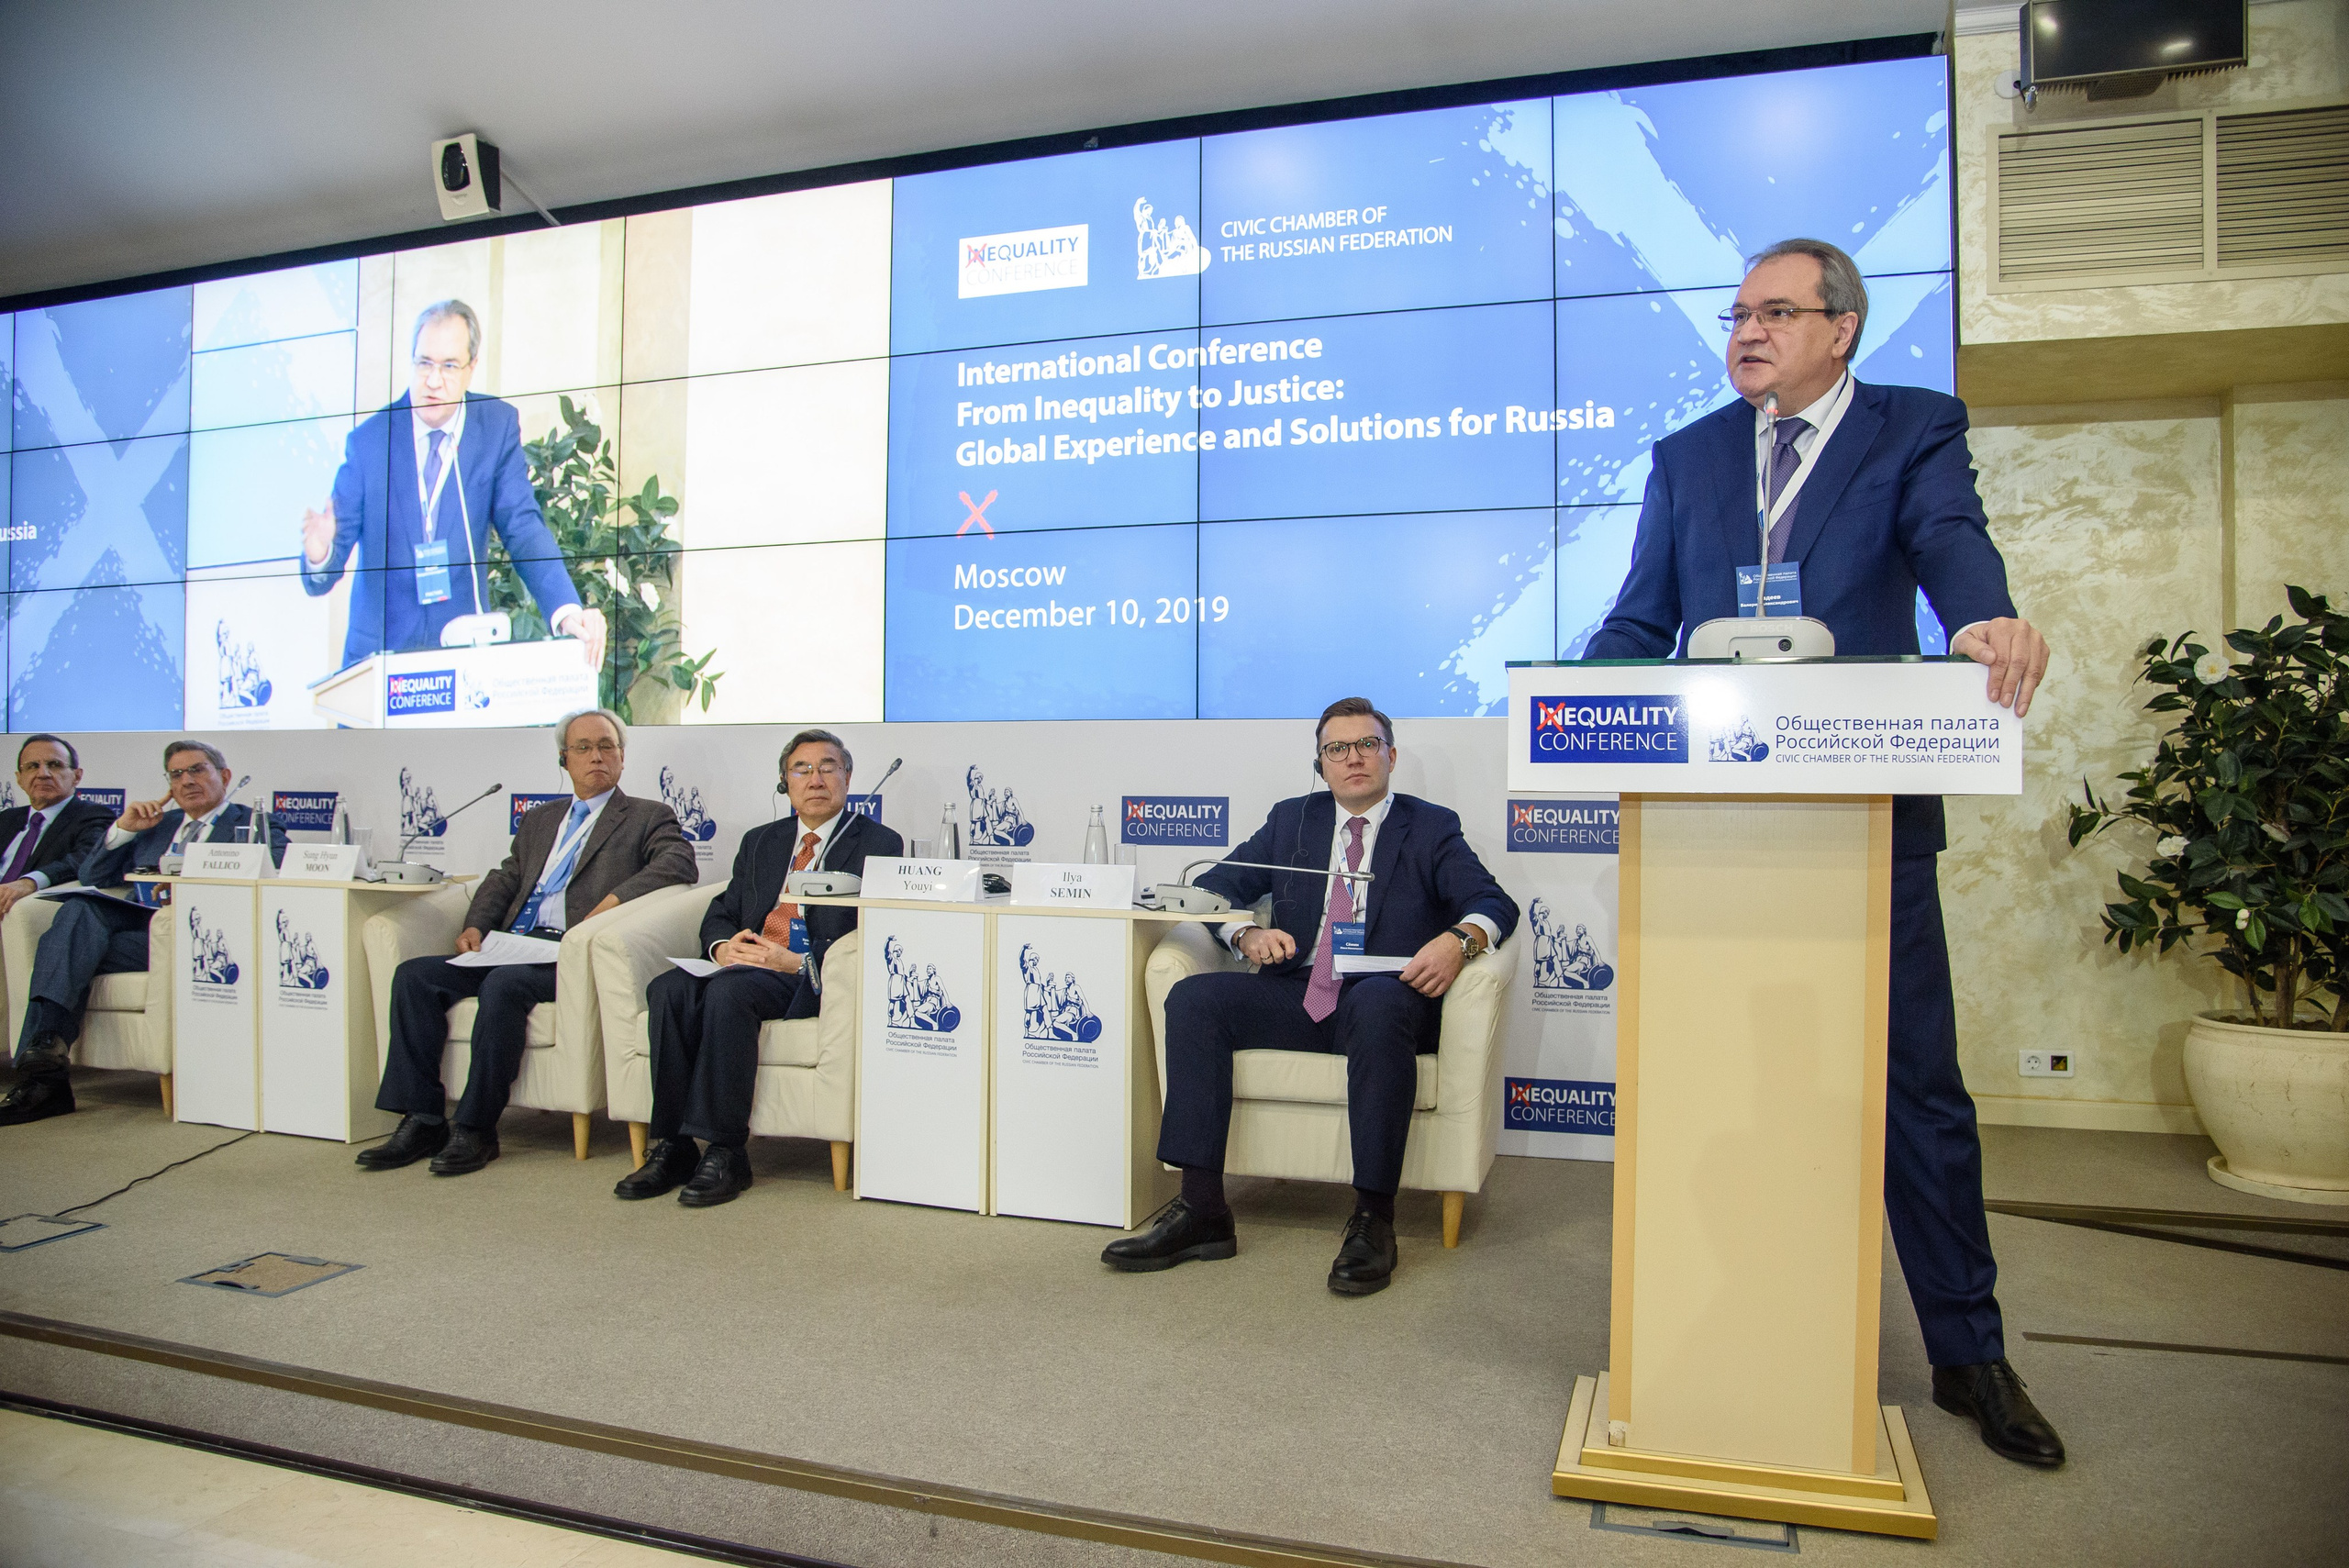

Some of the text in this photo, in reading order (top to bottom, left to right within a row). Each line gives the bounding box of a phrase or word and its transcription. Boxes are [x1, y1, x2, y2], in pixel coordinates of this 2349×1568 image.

[1221, 206, 1387, 238] CIVIC CHAMBER OF
[1220, 225, 1453, 262] THE RUSSIAN FEDERATION
[958, 337, 1322, 387] International Conference
[957, 375, 1344, 427] From Inequality to Justice:
[956, 400, 1615, 467] Global Experience and Solutions for Russia
[954, 563, 1066, 589] Moscow
[954, 596, 1229, 629] December 10, 2019
[390, 693, 451, 709] CONFERENCE
[1776, 716, 1999, 733] Общественная палата
[1539, 732, 1677, 751] CONFERENCE
[1776, 734, 1999, 752] Российской Федерации
[1776, 754, 2000, 763] CIVIC CHAMBER OF THE RUSSIAN FEDERATION
[80, 794, 123, 806] EQUALITY
[277, 812, 333, 824] ONFERENCE
[1127, 822, 1221, 837] CONFERENCE
[1513, 828, 1619, 844] CONFERENCE
[203, 861, 240, 869] FALLICO
[898, 865, 942, 875] HUANG
[1063, 872, 1082, 884] Ilya
[904, 881, 933, 893] Youyi
[1050, 887, 1092, 899] SEMIN
[888, 1031, 932, 1040] Общественная
[885, 1039, 957, 1051] Российской Федерации
[1024, 1042, 1072, 1052] Общественная
[1022, 1051, 1099, 1062] Российской Федерации
[1510, 1106, 1615, 1126] CONFERENCE
